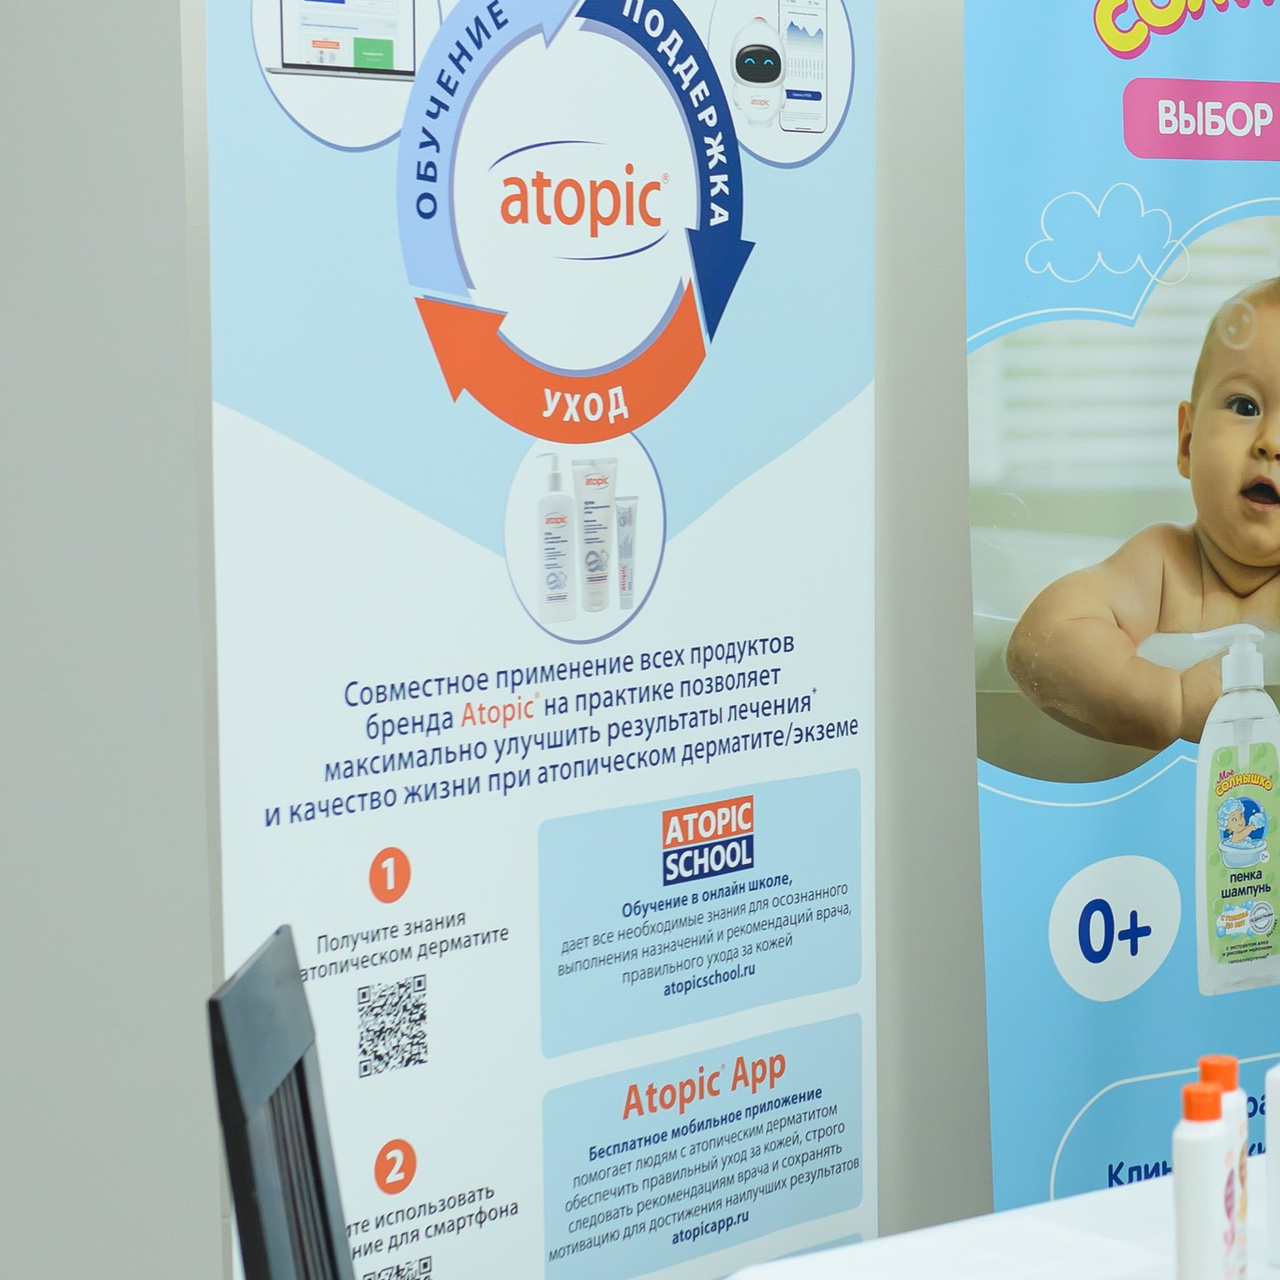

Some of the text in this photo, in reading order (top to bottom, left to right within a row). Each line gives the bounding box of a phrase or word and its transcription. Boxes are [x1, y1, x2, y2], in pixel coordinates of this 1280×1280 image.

[1158, 99, 1273, 138] ВЫБОР
[542, 385, 630, 425] УХОД
[344, 635, 794, 707] Совместное применение всех продуктов
[366, 710, 453, 744] бренда
[544, 696, 568, 716] на
[575, 682, 674, 716] практике
[680, 667, 781, 698] позволяет
[325, 740, 487, 781] максимально
[494, 725, 600, 764] улучшить
[607, 706, 722, 747] результаты
[265, 718, 858, 827] и качество жизни при атопическом дерматите/экземе
[665, 802, 752, 845] ATOPIC
[381, 857, 395, 891] 1
[665, 841, 752, 881] SCHOOL
[1229, 870, 1263, 884] пенка
[622, 874, 792, 919] Обучение в онлайн школе,
[1220, 884, 1272, 899] шампунь
[317, 912, 466, 954] Получите знания
[558, 903, 852, 976] выполнения назначений и рекомендаций врача,
[561, 883, 848, 955] дает все необходимые знания для осознанного
[1077, 897, 1152, 965] 0+
[416, 927, 509, 961] дерматите
[622, 931, 793, 986] правильного ухода за кожей
[663, 963, 755, 996] atopicschool.ru
[731, 1053, 786, 1094] App
[573, 1104, 838, 1188] помогает людям с атопическим дерматитом
[588, 1088, 822, 1162] Бесплатное мобильное приложение
[385, 1148, 405, 1184] 2
[564, 1122, 845, 1213] обеспечить правильный уход за кожей, строго
[568, 1143, 843, 1233] следовать рекомендациям врача и сохранять
[375, 1186, 495, 1229] использовать
[387, 1202, 518, 1253] для смартфона
[548, 1157, 860, 1262] мотивацию для достижения наилучших результатов
[672, 1210, 749, 1245] atopicapp.ru
